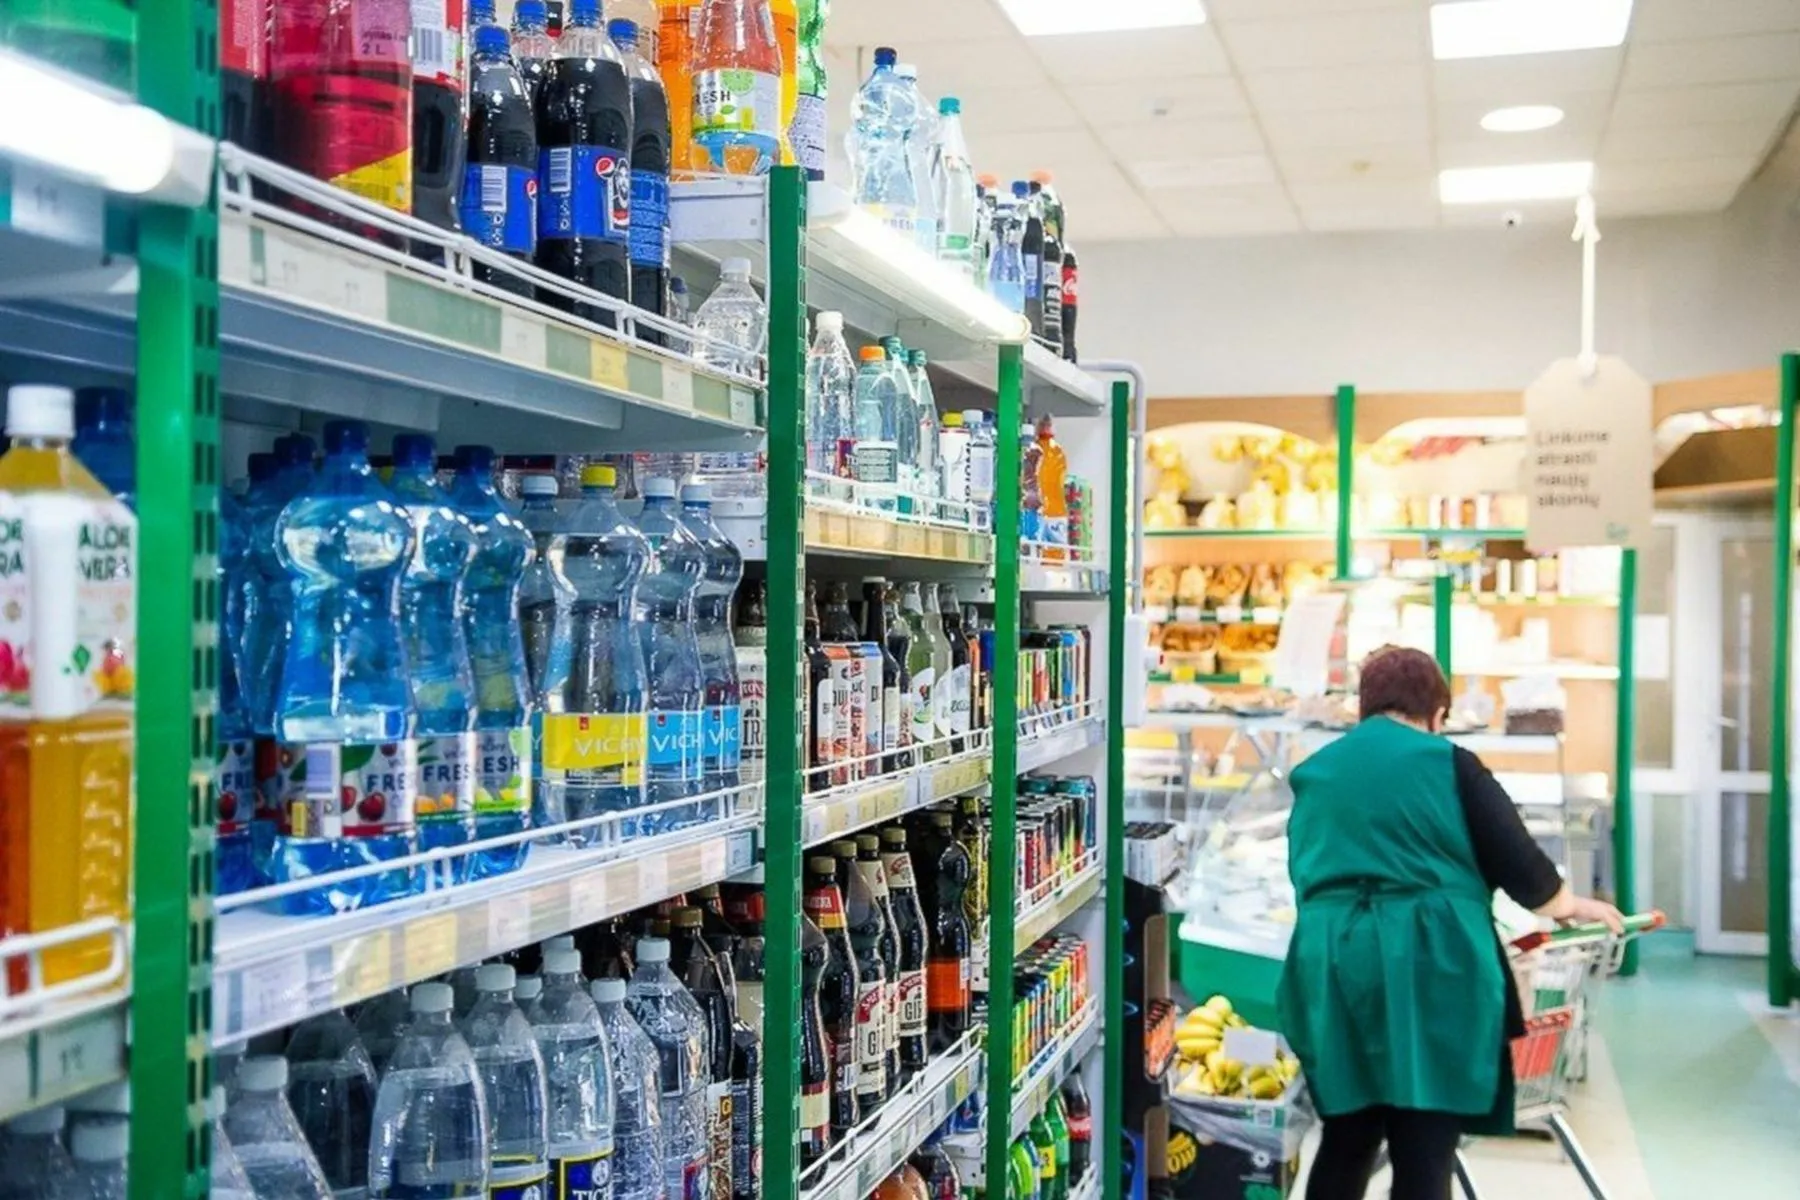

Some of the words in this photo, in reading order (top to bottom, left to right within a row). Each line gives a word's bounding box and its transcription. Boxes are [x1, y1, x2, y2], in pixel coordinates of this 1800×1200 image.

[78, 523, 131, 550] ALOE
[79, 556, 131, 581] VERA
[651, 731, 701, 753] VICH
[475, 755, 520, 774] ESH
